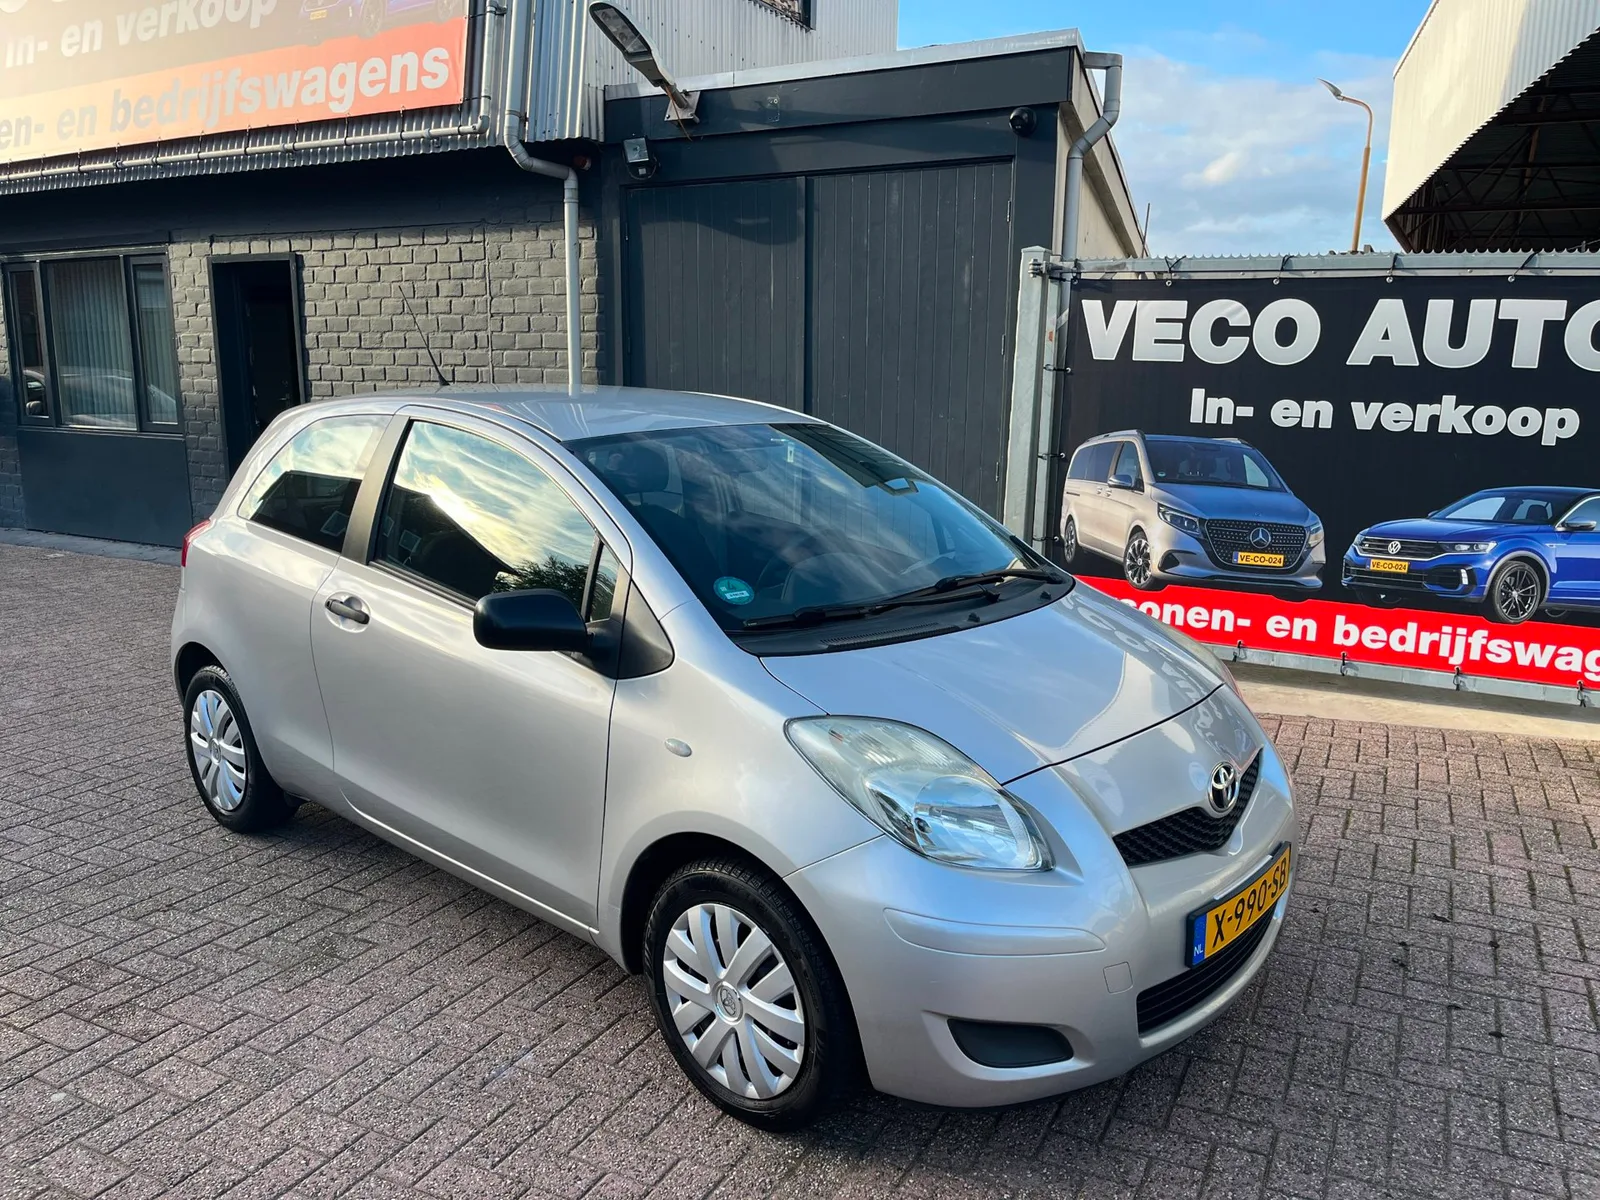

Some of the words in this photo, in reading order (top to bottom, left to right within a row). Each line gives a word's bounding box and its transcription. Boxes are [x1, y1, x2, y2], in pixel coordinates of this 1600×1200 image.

[61, 18, 104, 57] en
[116, 0, 278, 46] verkoop
[57, 104, 98, 141] en
[110, 47, 450, 132] bedrijfswagens
[1081, 298, 1321, 365] VECO
[1190, 388, 1254, 425] In-
[1270, 398, 1334, 430] en
[1351, 394, 1581, 447] verkoop
[1239, 554, 1282, 565] VE-CO-024
[1371, 561, 1407, 571] VE-CO-024
[1266, 606, 1318, 641] en
[1212, 856, 1287, 949] X-990-SB
[1194, 944, 1203, 956] NL
